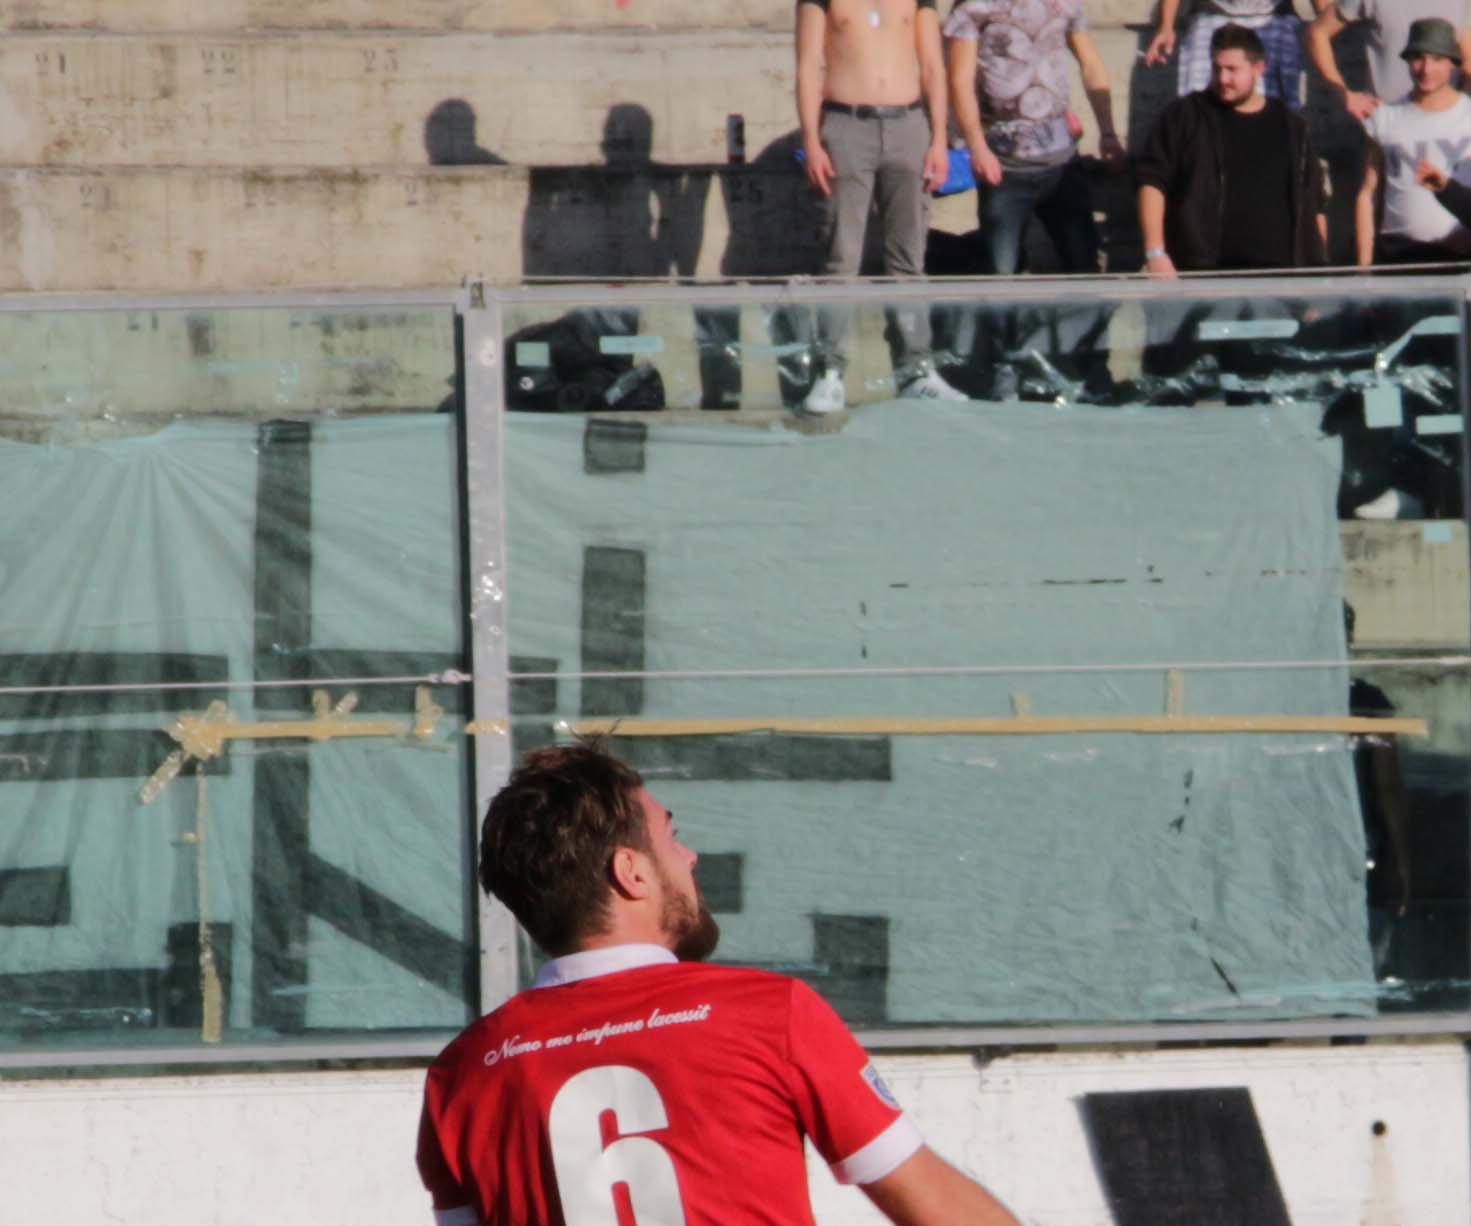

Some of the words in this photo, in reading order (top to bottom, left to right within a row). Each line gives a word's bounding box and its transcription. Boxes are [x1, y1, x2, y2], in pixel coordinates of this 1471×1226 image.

[484, 1035, 542, 1066] Nemo
[545, 1034, 574, 1049] me
[576, 1018, 645, 1046] impune
[647, 1004, 711, 1029] lacessit
